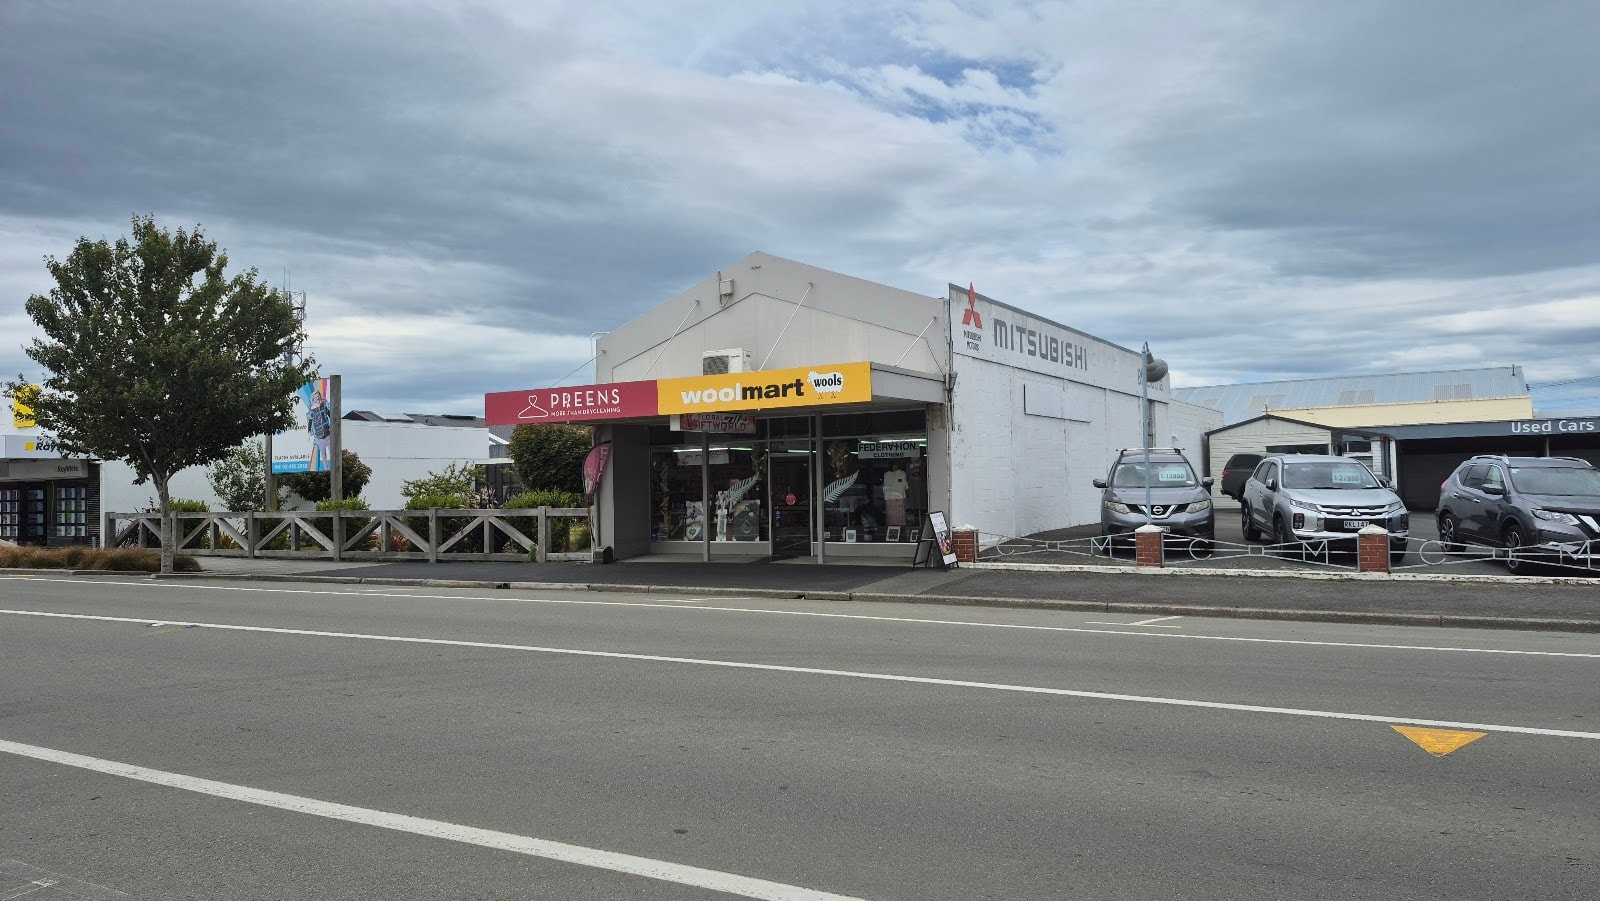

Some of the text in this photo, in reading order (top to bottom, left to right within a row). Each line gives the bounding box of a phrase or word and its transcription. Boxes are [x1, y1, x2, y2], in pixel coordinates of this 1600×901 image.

[993, 318, 1088, 371] MITSUBISHI
[680, 378, 804, 404] woolmart
[813, 373, 842, 388] wools
[550, 388, 620, 409] PREENS
[1511, 420, 1595, 433] Used Cars
